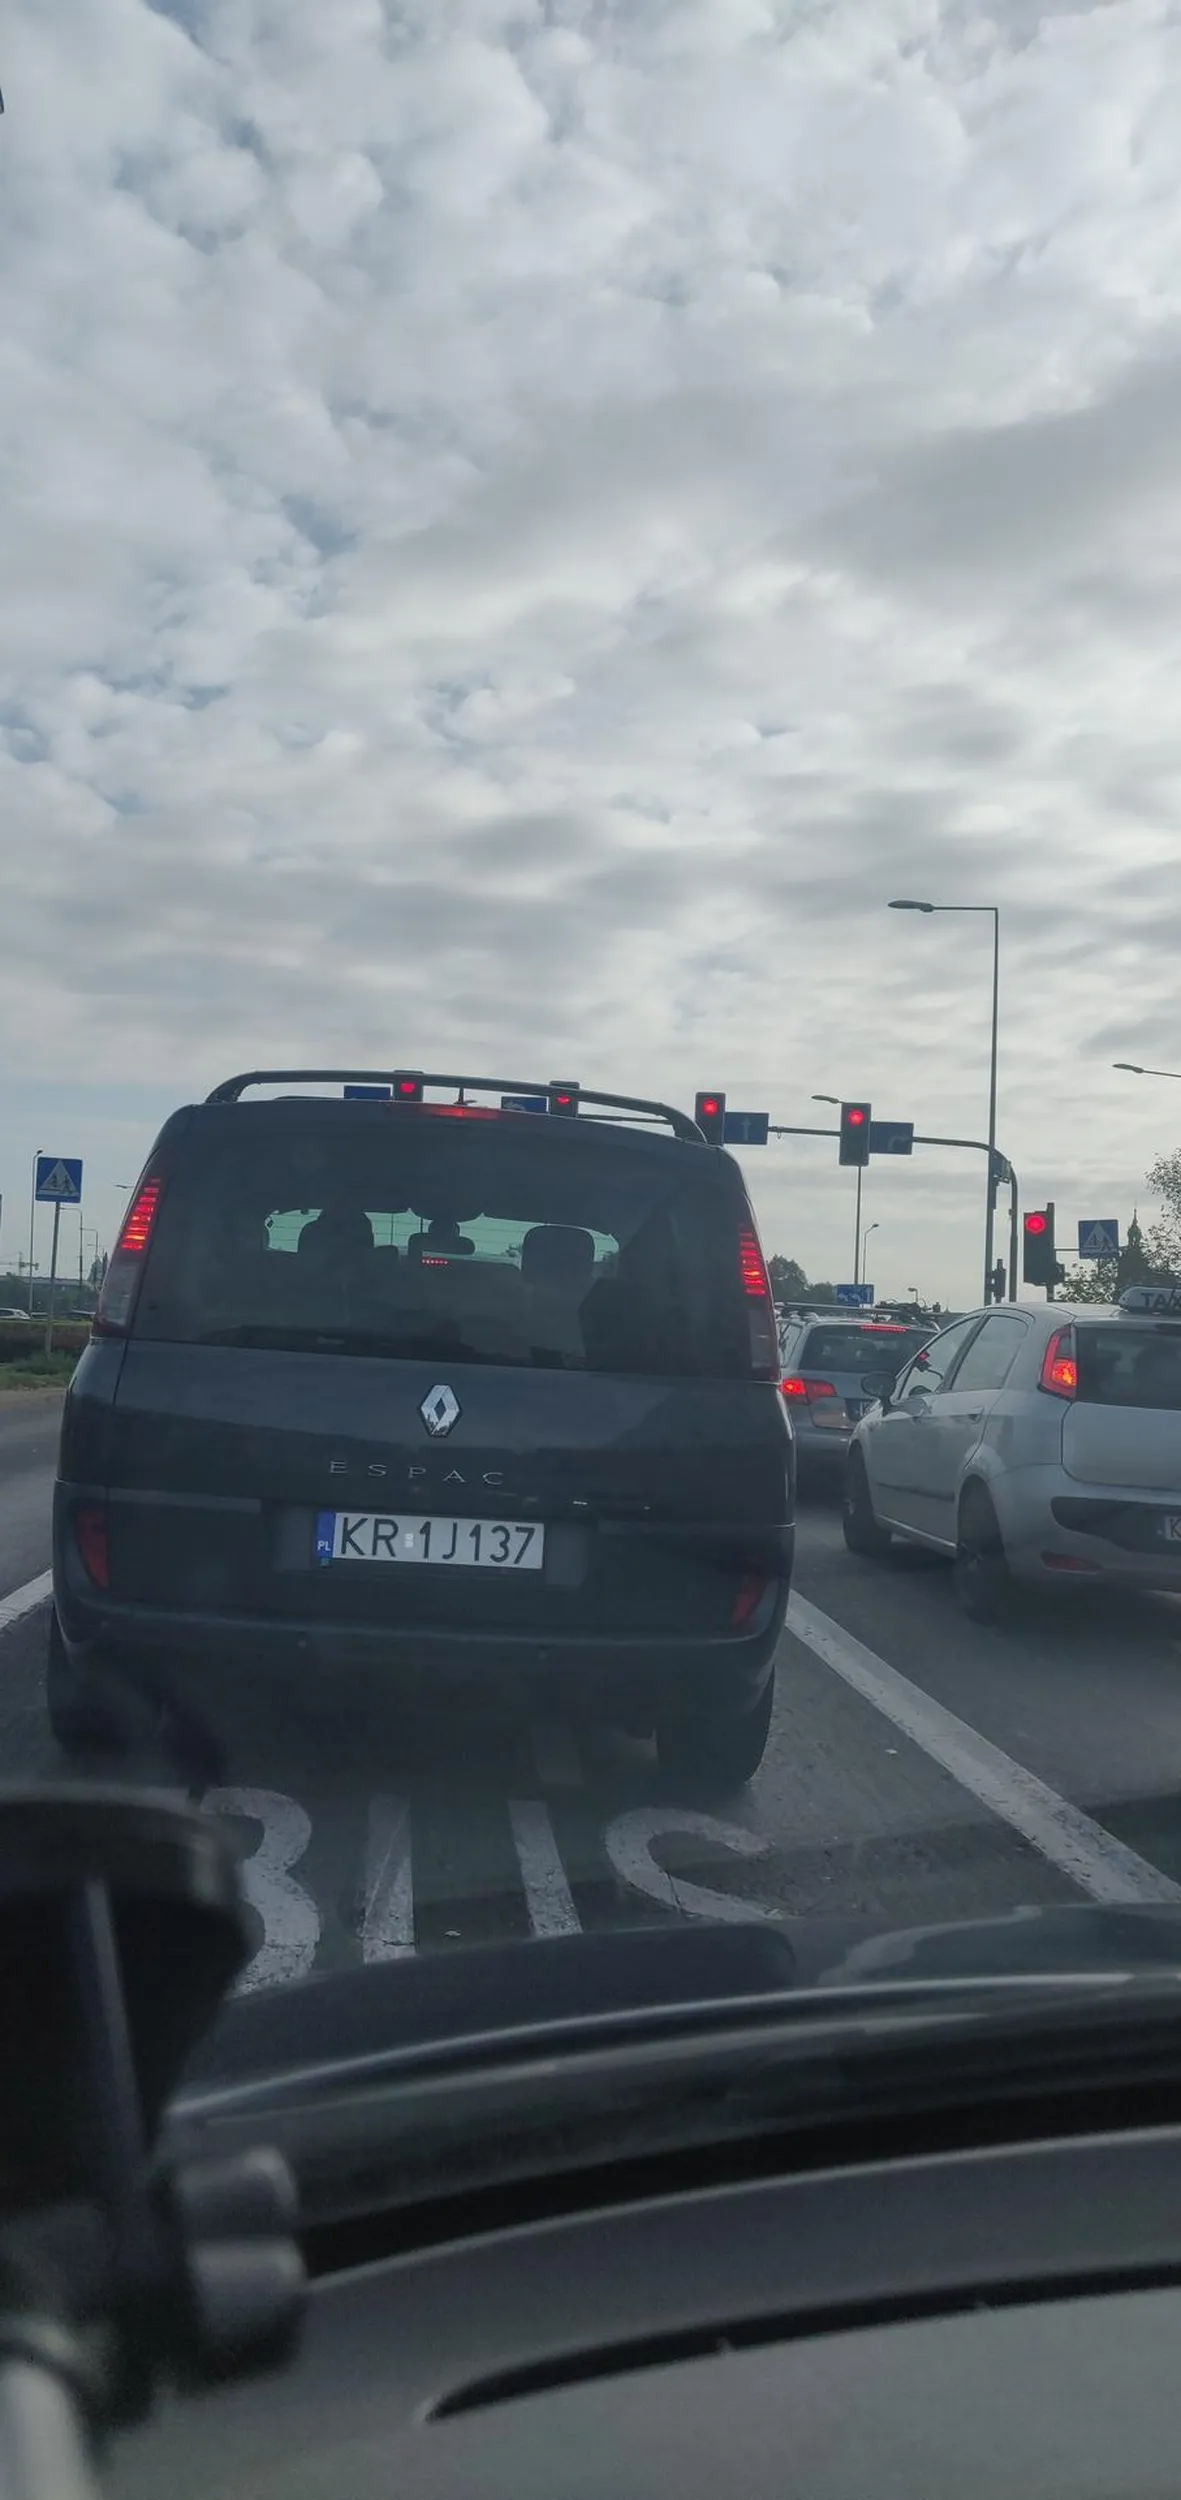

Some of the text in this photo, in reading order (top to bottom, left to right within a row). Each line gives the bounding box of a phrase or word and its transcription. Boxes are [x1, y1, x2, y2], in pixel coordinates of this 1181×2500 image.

[1140, 1291, 1181, 1312] TAX
[329, 1460, 503, 1485] ESPAC
[317, 1540, 331, 1551] PL
[340, 1516, 536, 1565] KR 1J137
